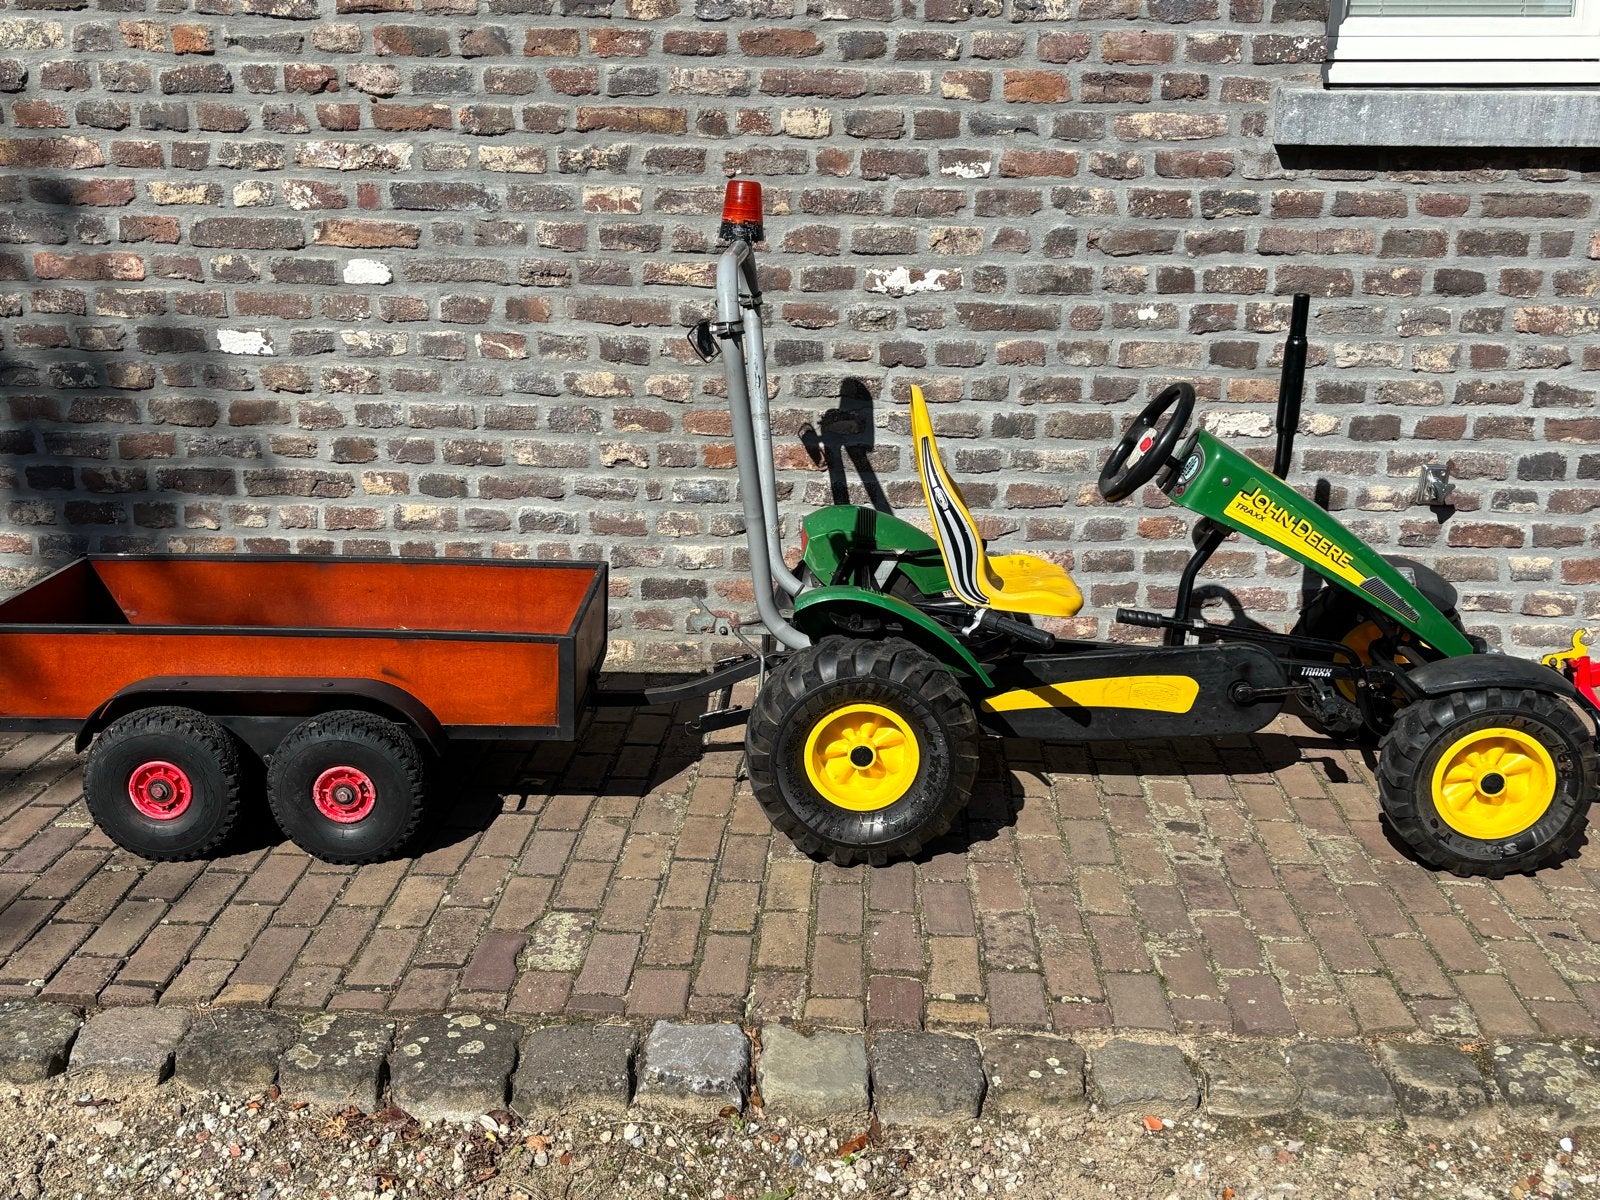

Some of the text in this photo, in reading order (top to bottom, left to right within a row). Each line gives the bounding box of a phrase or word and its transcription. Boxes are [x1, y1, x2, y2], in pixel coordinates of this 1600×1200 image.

[1235, 502, 1267, 522] TRAXX
[1241, 487, 1353, 568] JOHN DEERE
[1300, 666, 1333, 678] TRAXX
